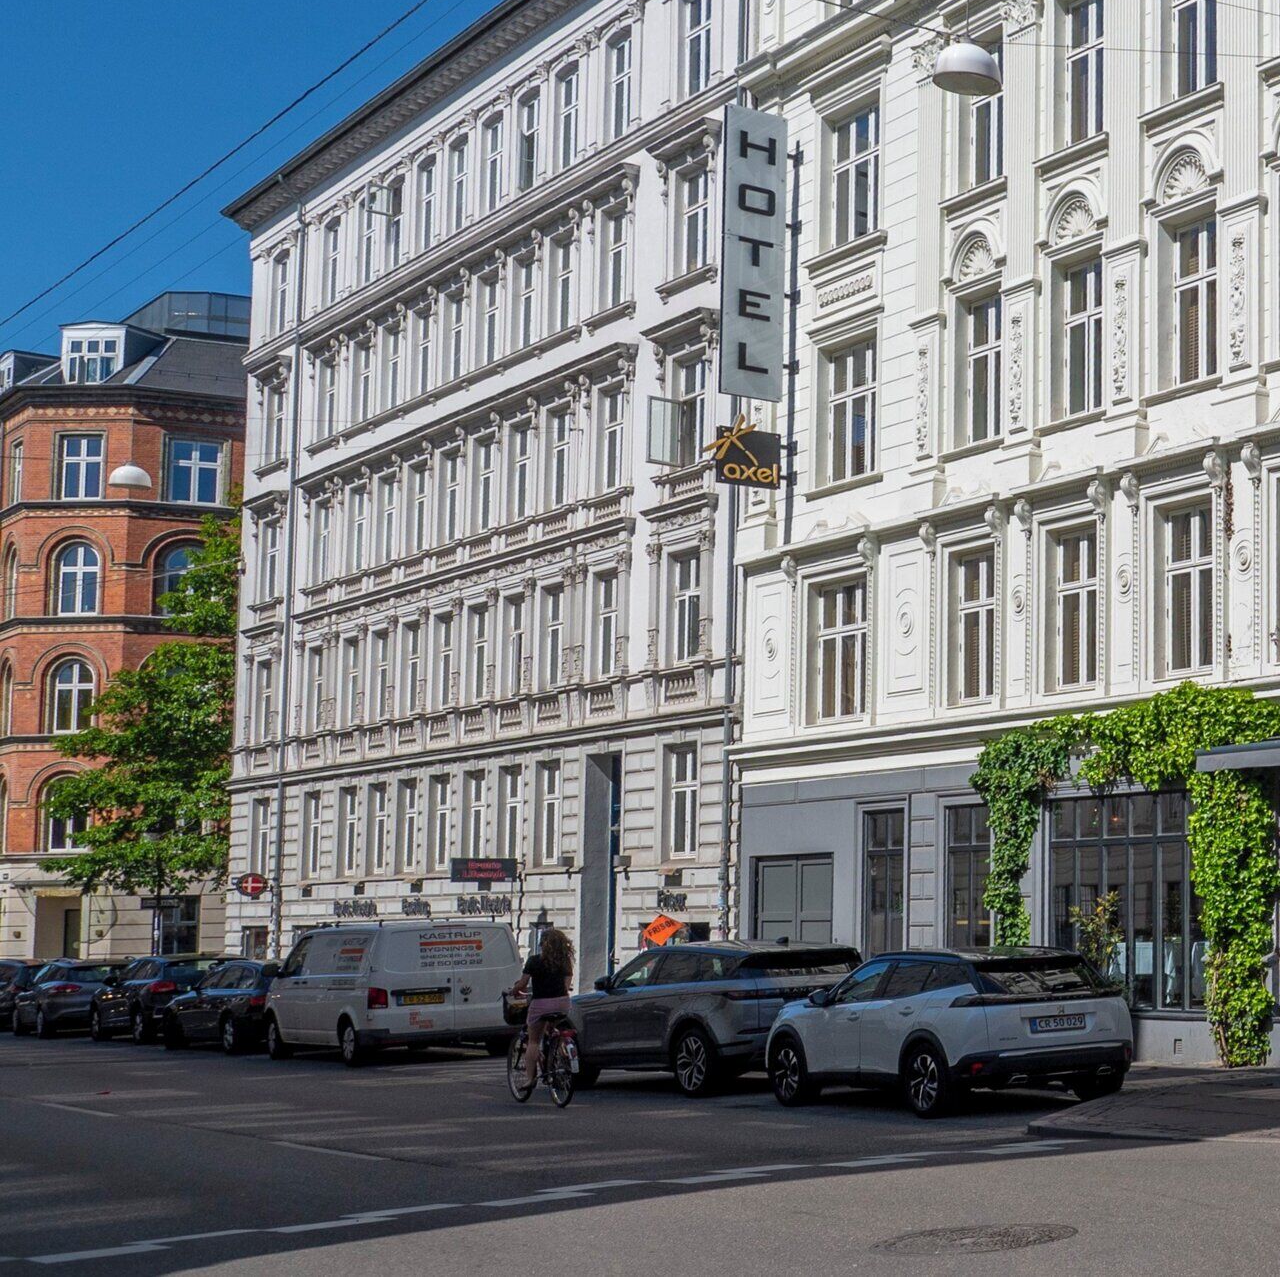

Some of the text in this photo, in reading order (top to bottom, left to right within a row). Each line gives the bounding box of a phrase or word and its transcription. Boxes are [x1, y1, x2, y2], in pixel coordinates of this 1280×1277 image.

[738, 130, 776, 375] HOTEL
[723, 463, 779, 485] axel
[419, 931, 482, 940] KASTRUP
[420, 945, 475, 953] BYGNINGS
[1039, 1017, 1083, 1029] CR 50 029
